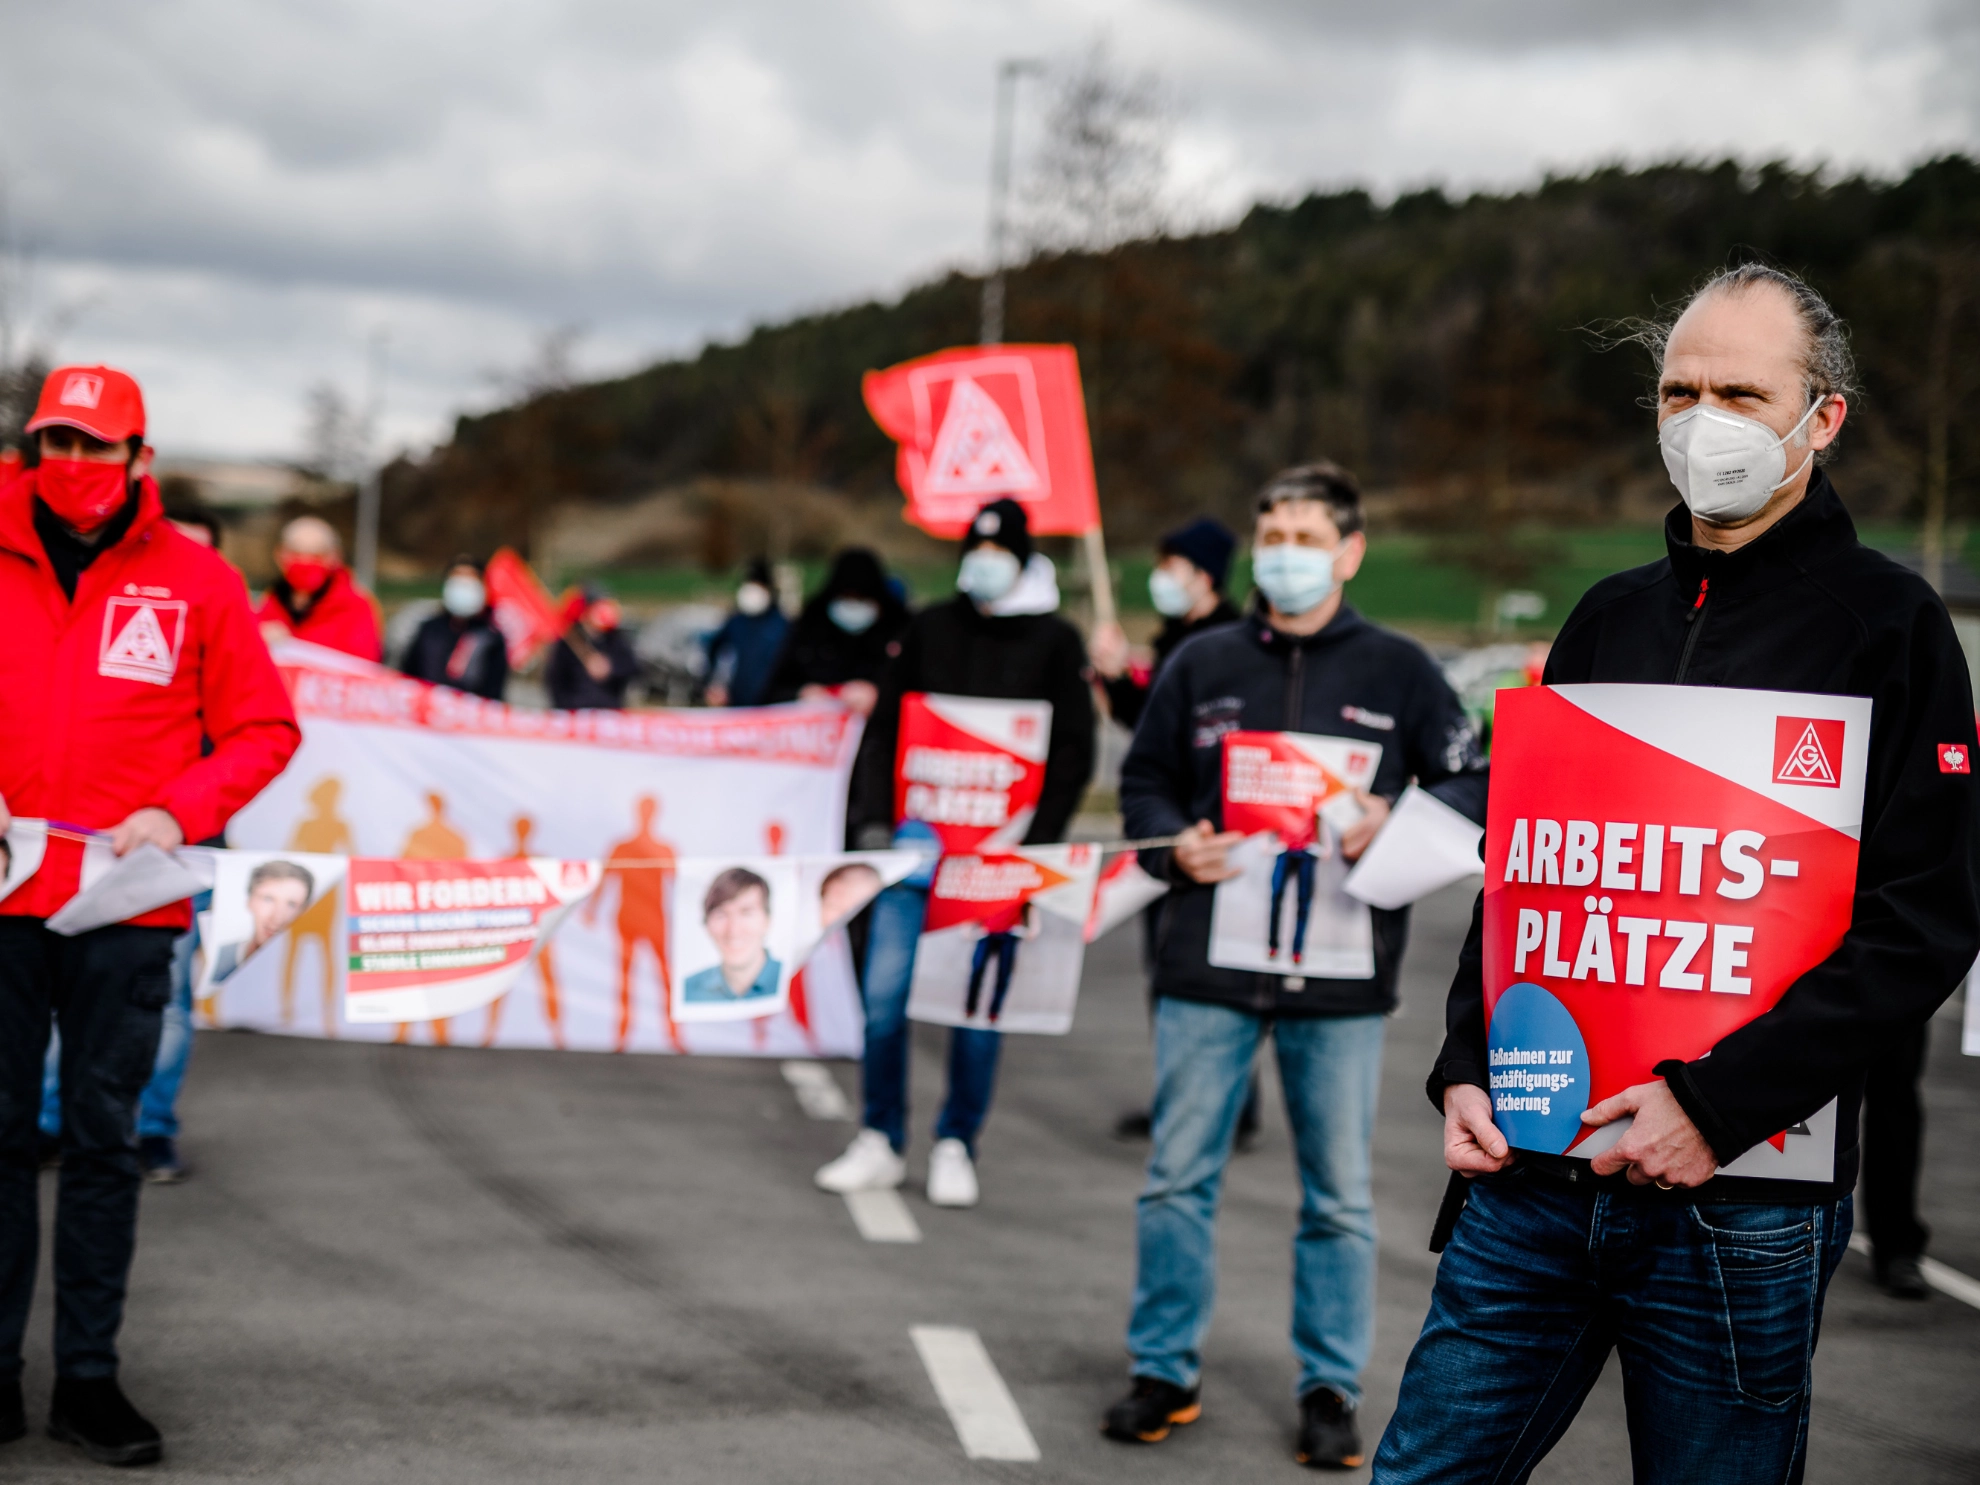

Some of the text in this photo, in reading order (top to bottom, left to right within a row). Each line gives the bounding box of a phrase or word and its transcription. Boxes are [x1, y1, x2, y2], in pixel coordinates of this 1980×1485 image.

[1504, 818, 1799, 900] ARBEITS-
[355, 877, 547, 911] WIR FORDERN
[1514, 896, 1754, 995] PLÄTZE
[1490, 1047, 1573, 1066] Maßnahmen zur
[1490, 1069, 1575, 1092] Beschäftigungs-
[1496, 1093, 1551, 1115] sicherung
